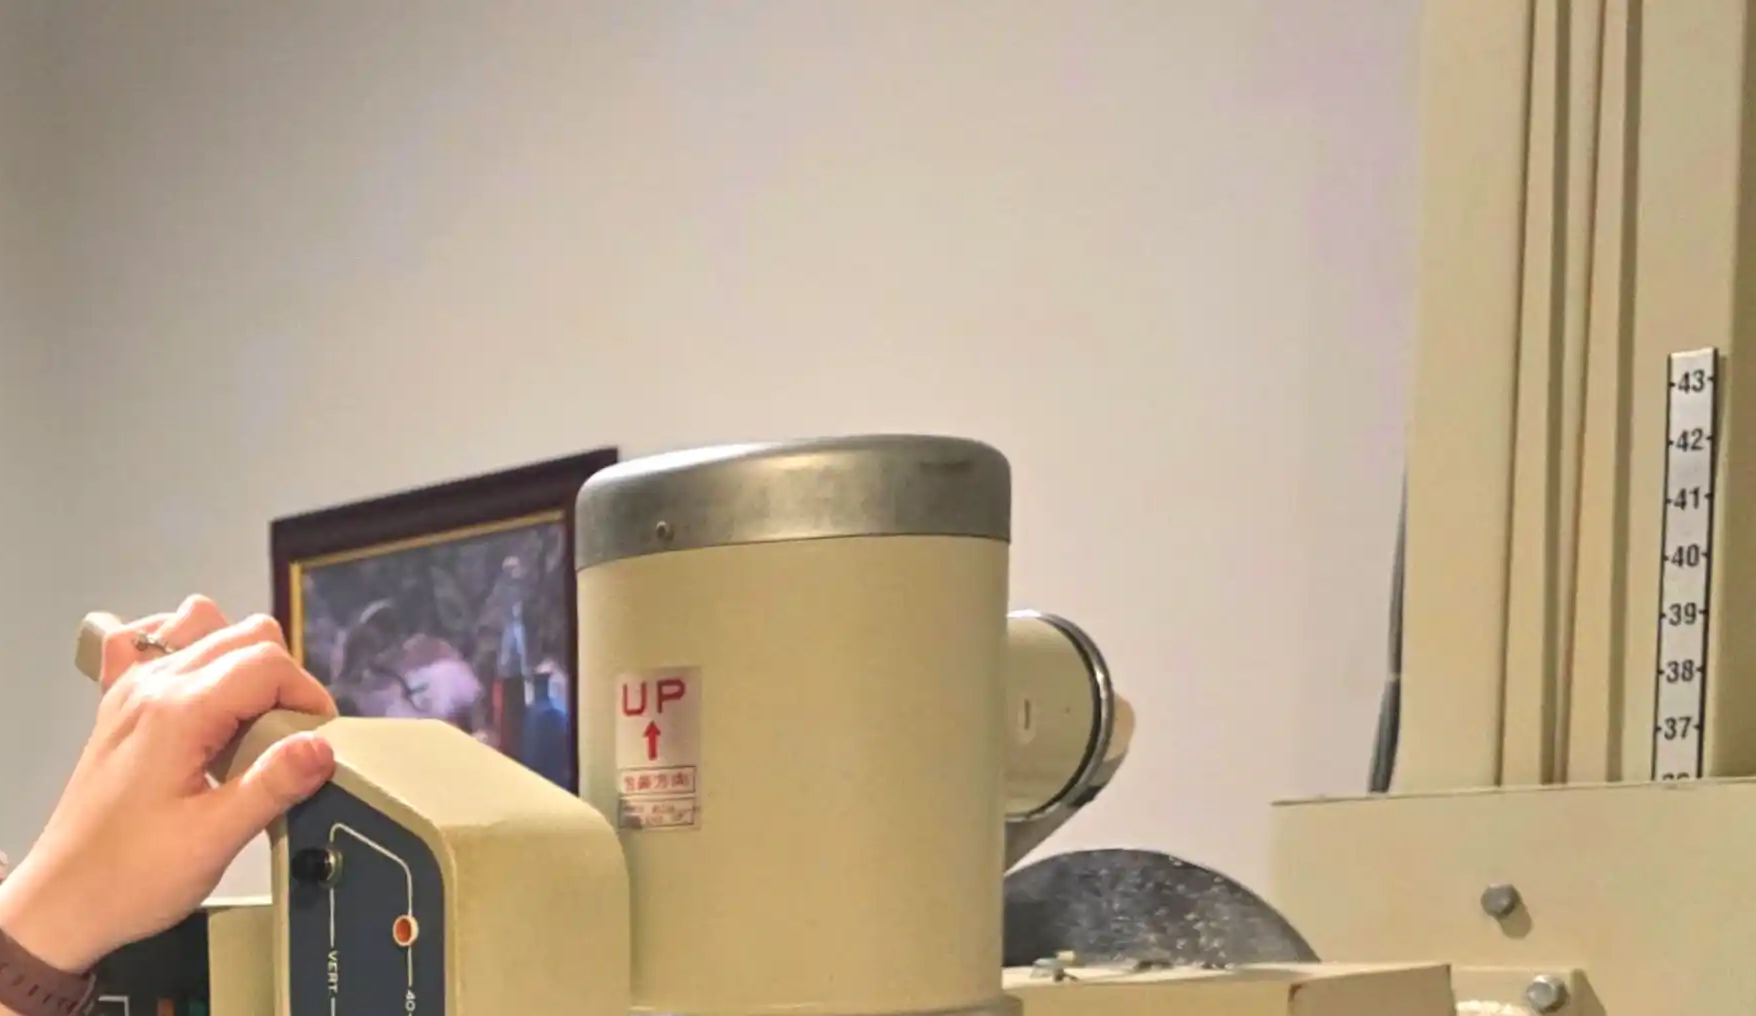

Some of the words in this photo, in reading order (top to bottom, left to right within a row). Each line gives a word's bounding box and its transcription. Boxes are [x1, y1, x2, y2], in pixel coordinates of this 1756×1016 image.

[1678, 369, 1705, 394] 43
[1676, 428, 1703, 452] 42
[1673, 486, 1700, 511] 41
[1671, 543, 1700, 568] 40
[1668, 602, 1697, 627] 39
[1666, 659, 1694, 684] 38
[622, 679, 686, 716] UP
[1664, 716, 1692, 740] 37
[405, 989, 417, 1012] 40
